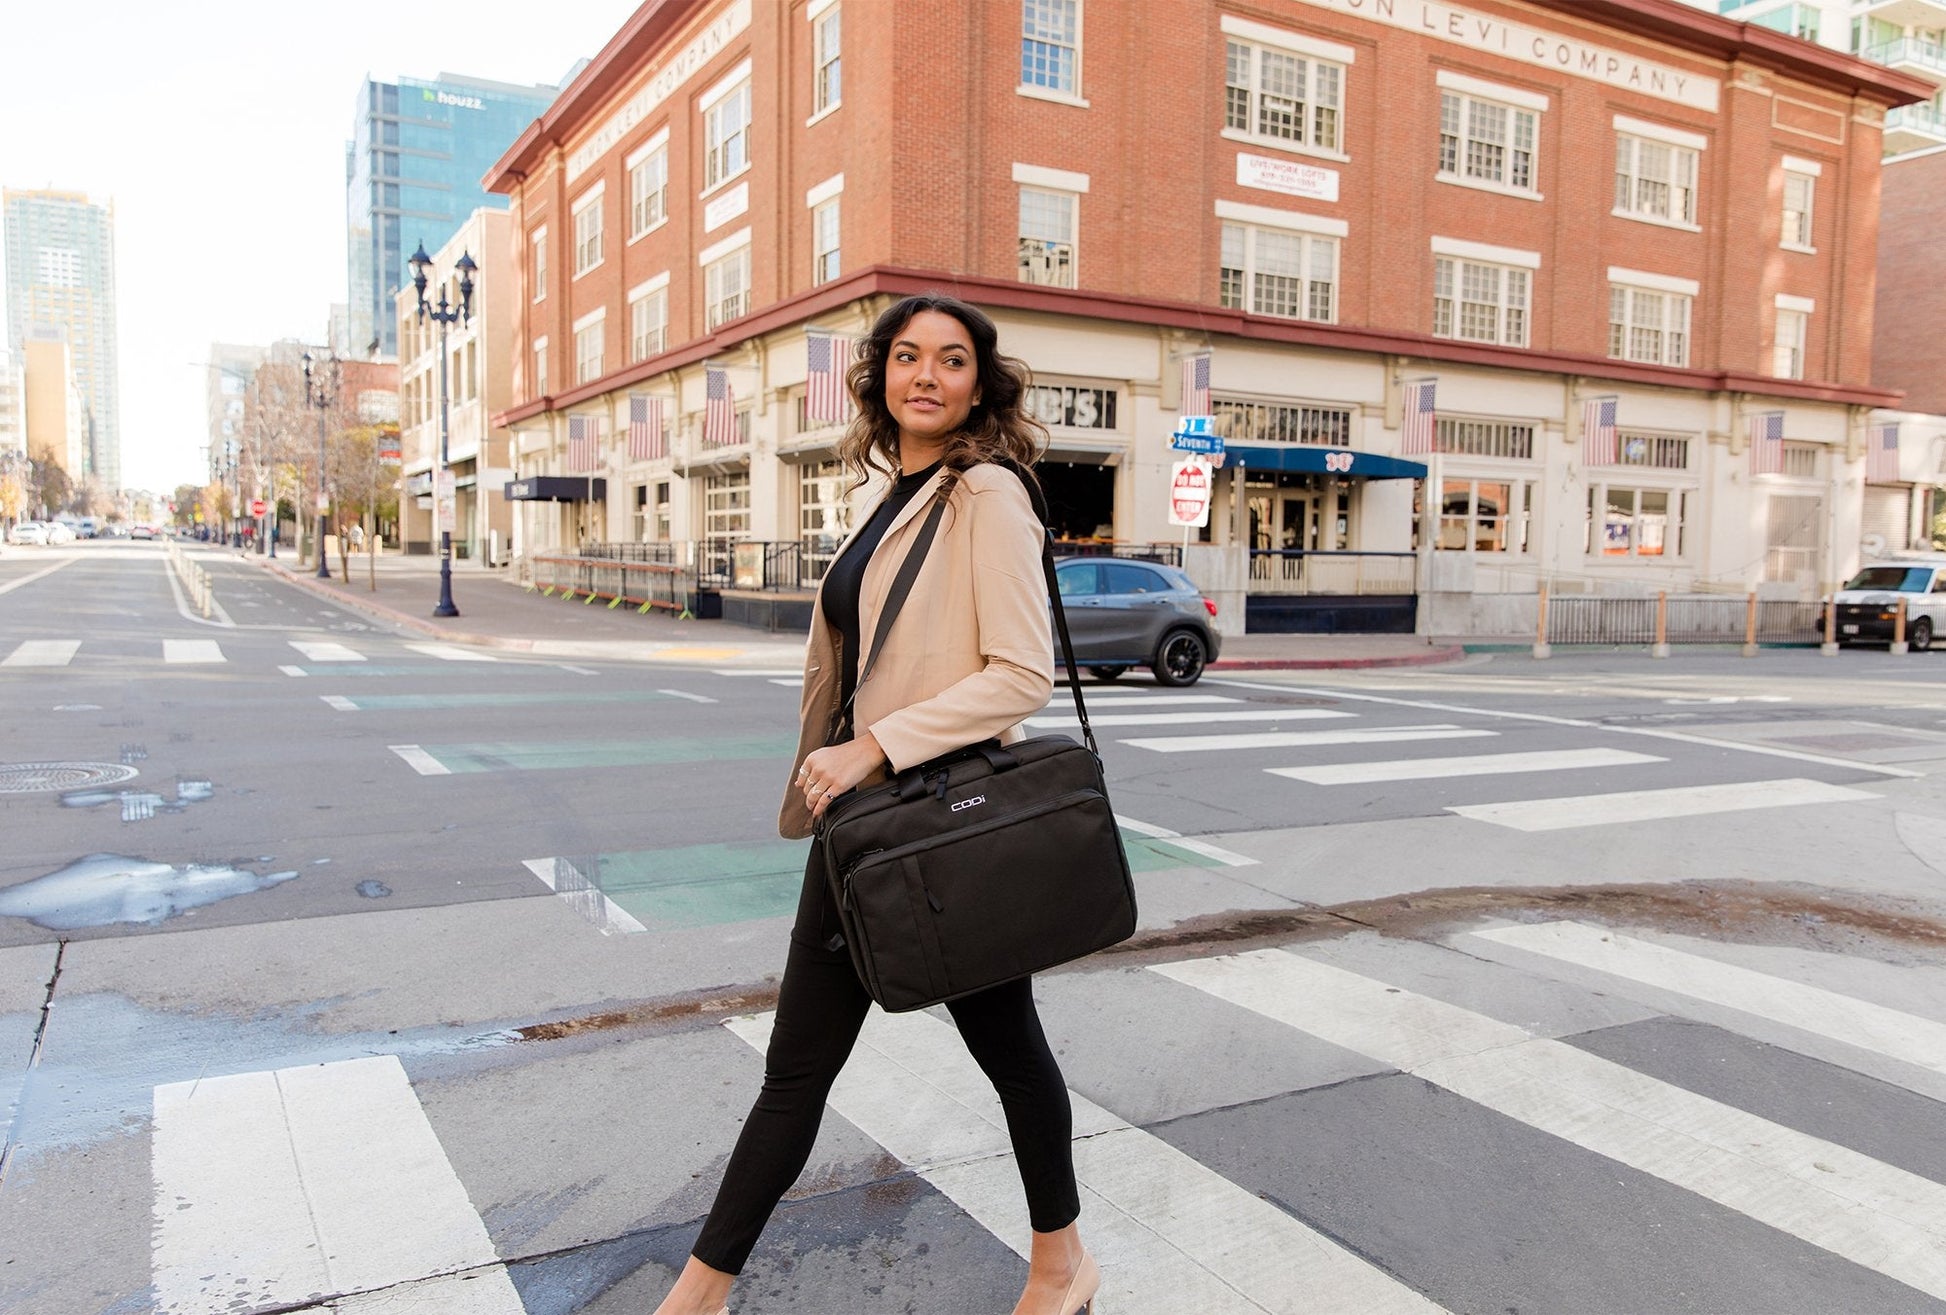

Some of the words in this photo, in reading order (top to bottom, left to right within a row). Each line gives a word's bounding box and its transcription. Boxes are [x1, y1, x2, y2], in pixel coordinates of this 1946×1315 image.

[654, 12, 735, 101] COMPANY
[1422, 6, 1507, 49] LEVI
[1531, 37, 1687, 95] COMPANY
[1024, 387, 1099, 427] B'S
[1188, 419, 1196, 433] J
[1176, 474, 1189, 486] DO
[1175, 501, 1202, 514] ENTER
